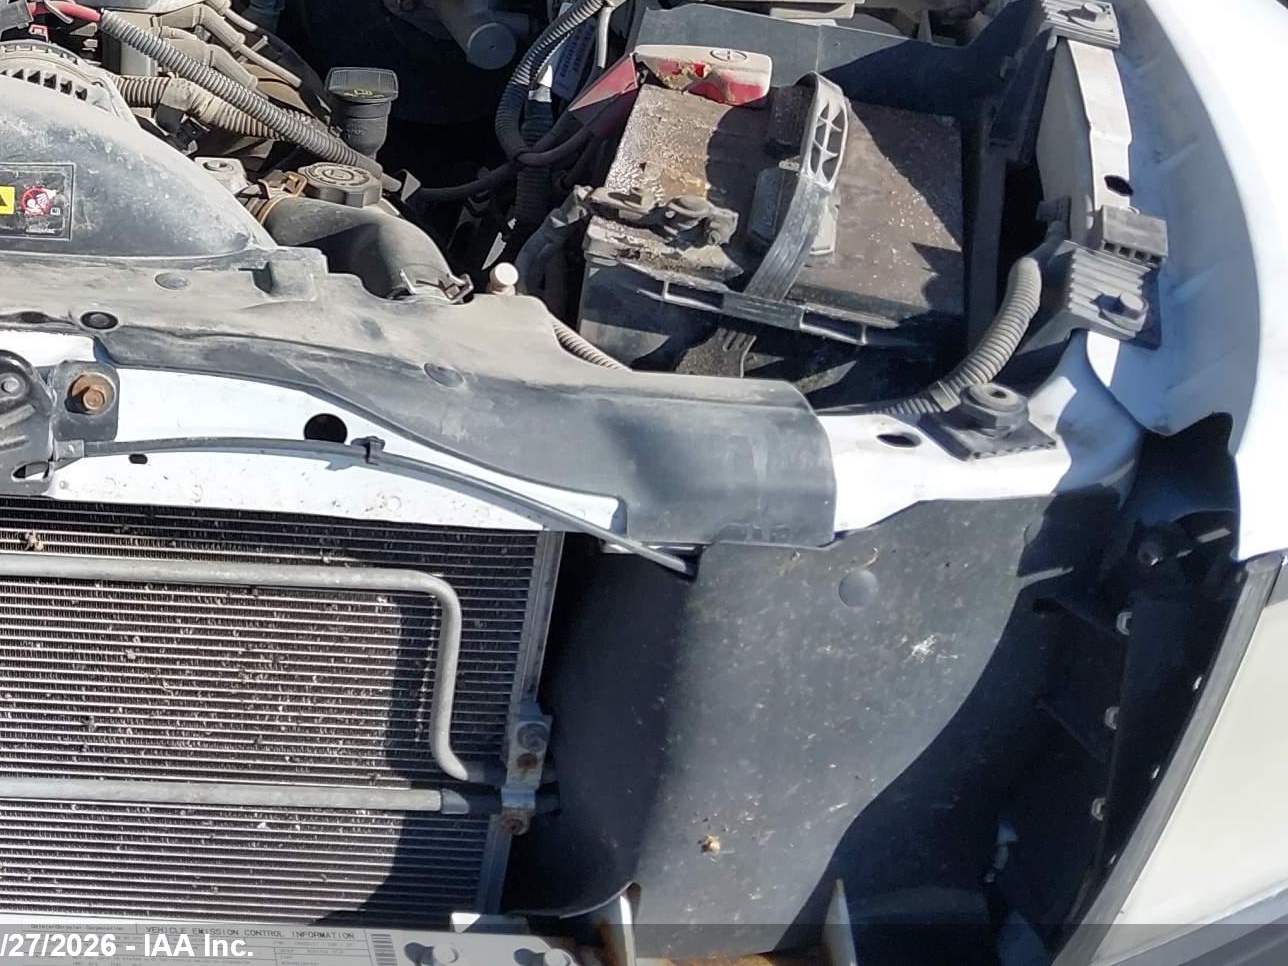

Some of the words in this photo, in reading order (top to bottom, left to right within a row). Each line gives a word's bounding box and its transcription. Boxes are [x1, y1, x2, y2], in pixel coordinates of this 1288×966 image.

[145, 926, 187, 934] VEHICLE
[192, 927, 239, 936] EMISSION
[244, 929, 285, 938] CONTROL
[292, 931, 355, 940] INFORMATION
